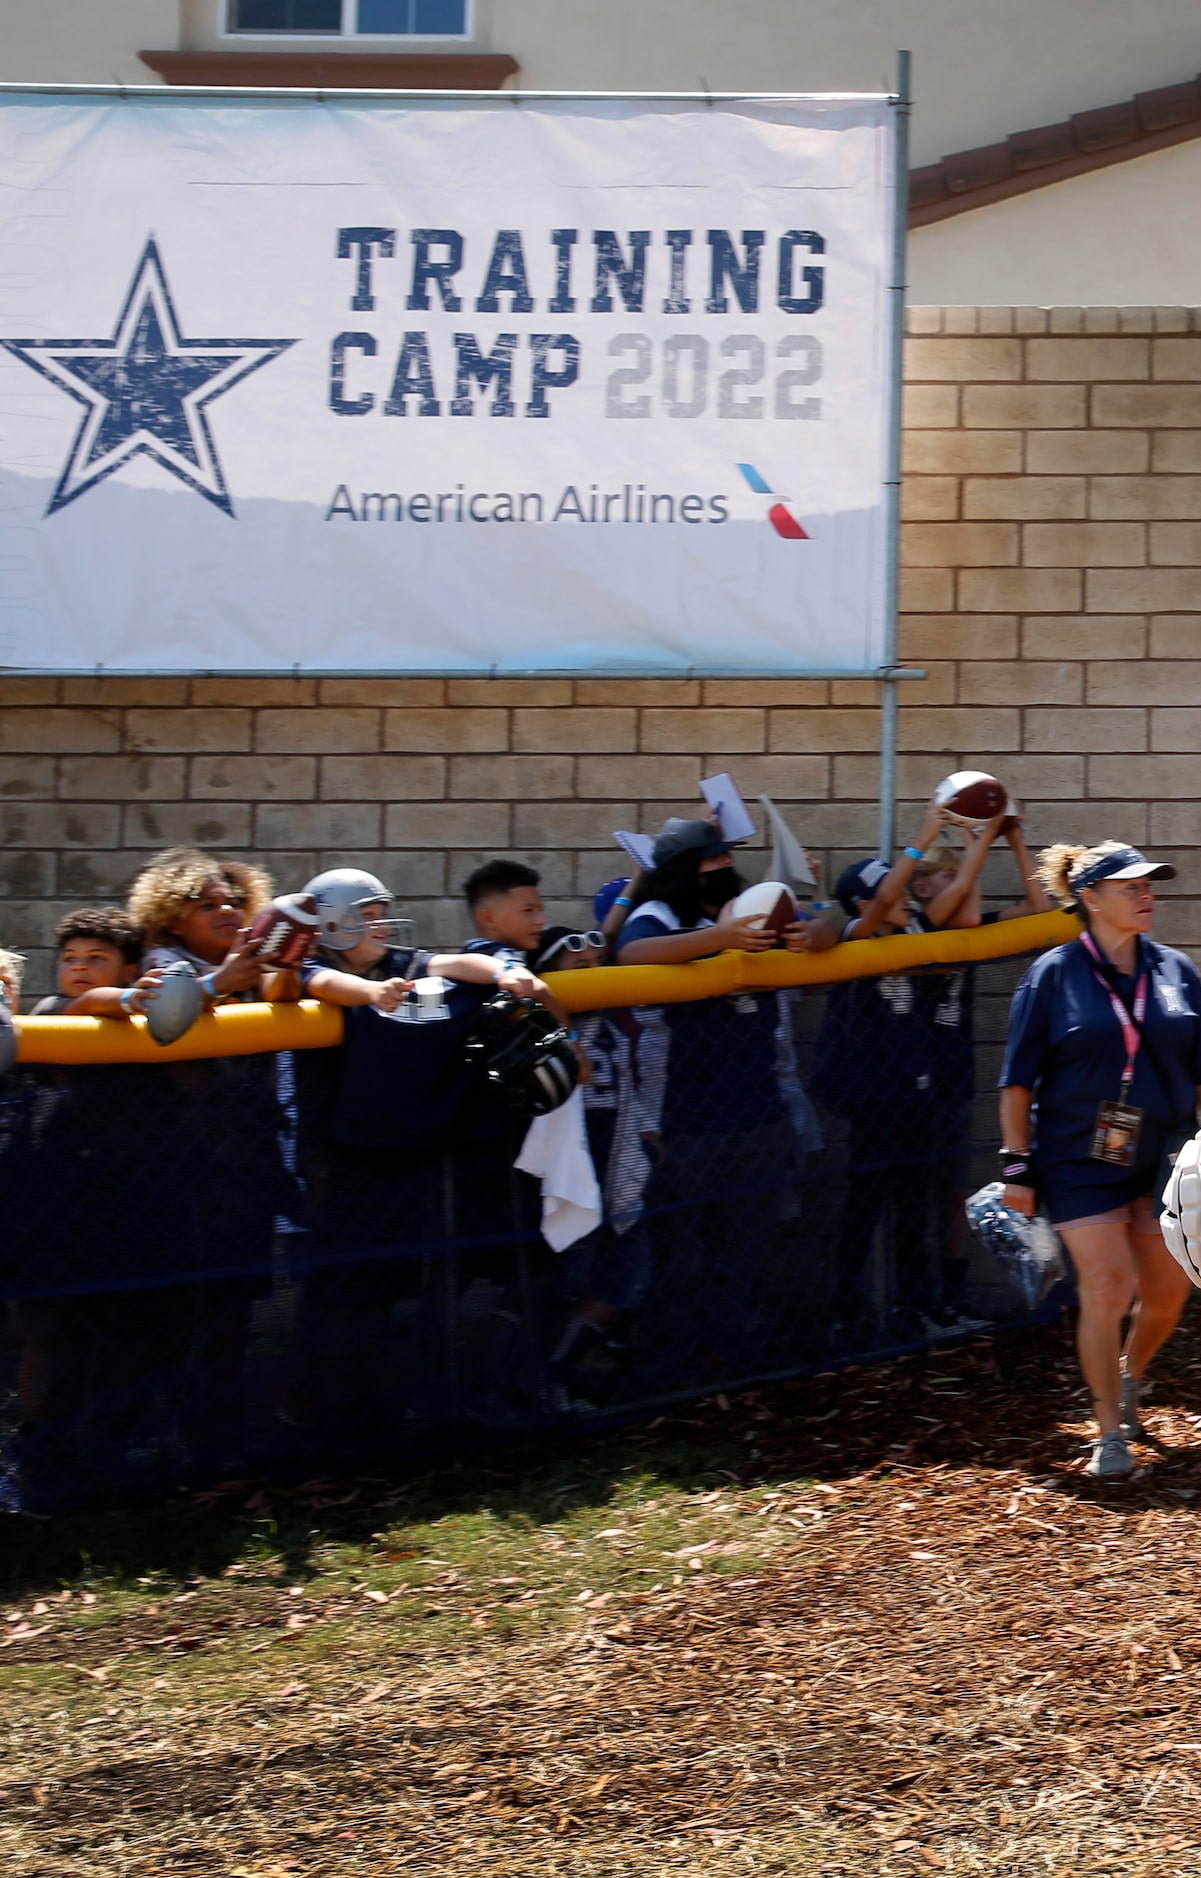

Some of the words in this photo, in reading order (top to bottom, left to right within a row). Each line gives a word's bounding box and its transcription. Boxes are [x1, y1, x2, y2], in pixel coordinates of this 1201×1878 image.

[336, 226, 828, 315] TRAINING
[328, 331, 581, 419] CAMP
[605, 332, 825, 421] 2022
[325, 483, 542, 524] American
[552, 484, 729, 525] Airlines
